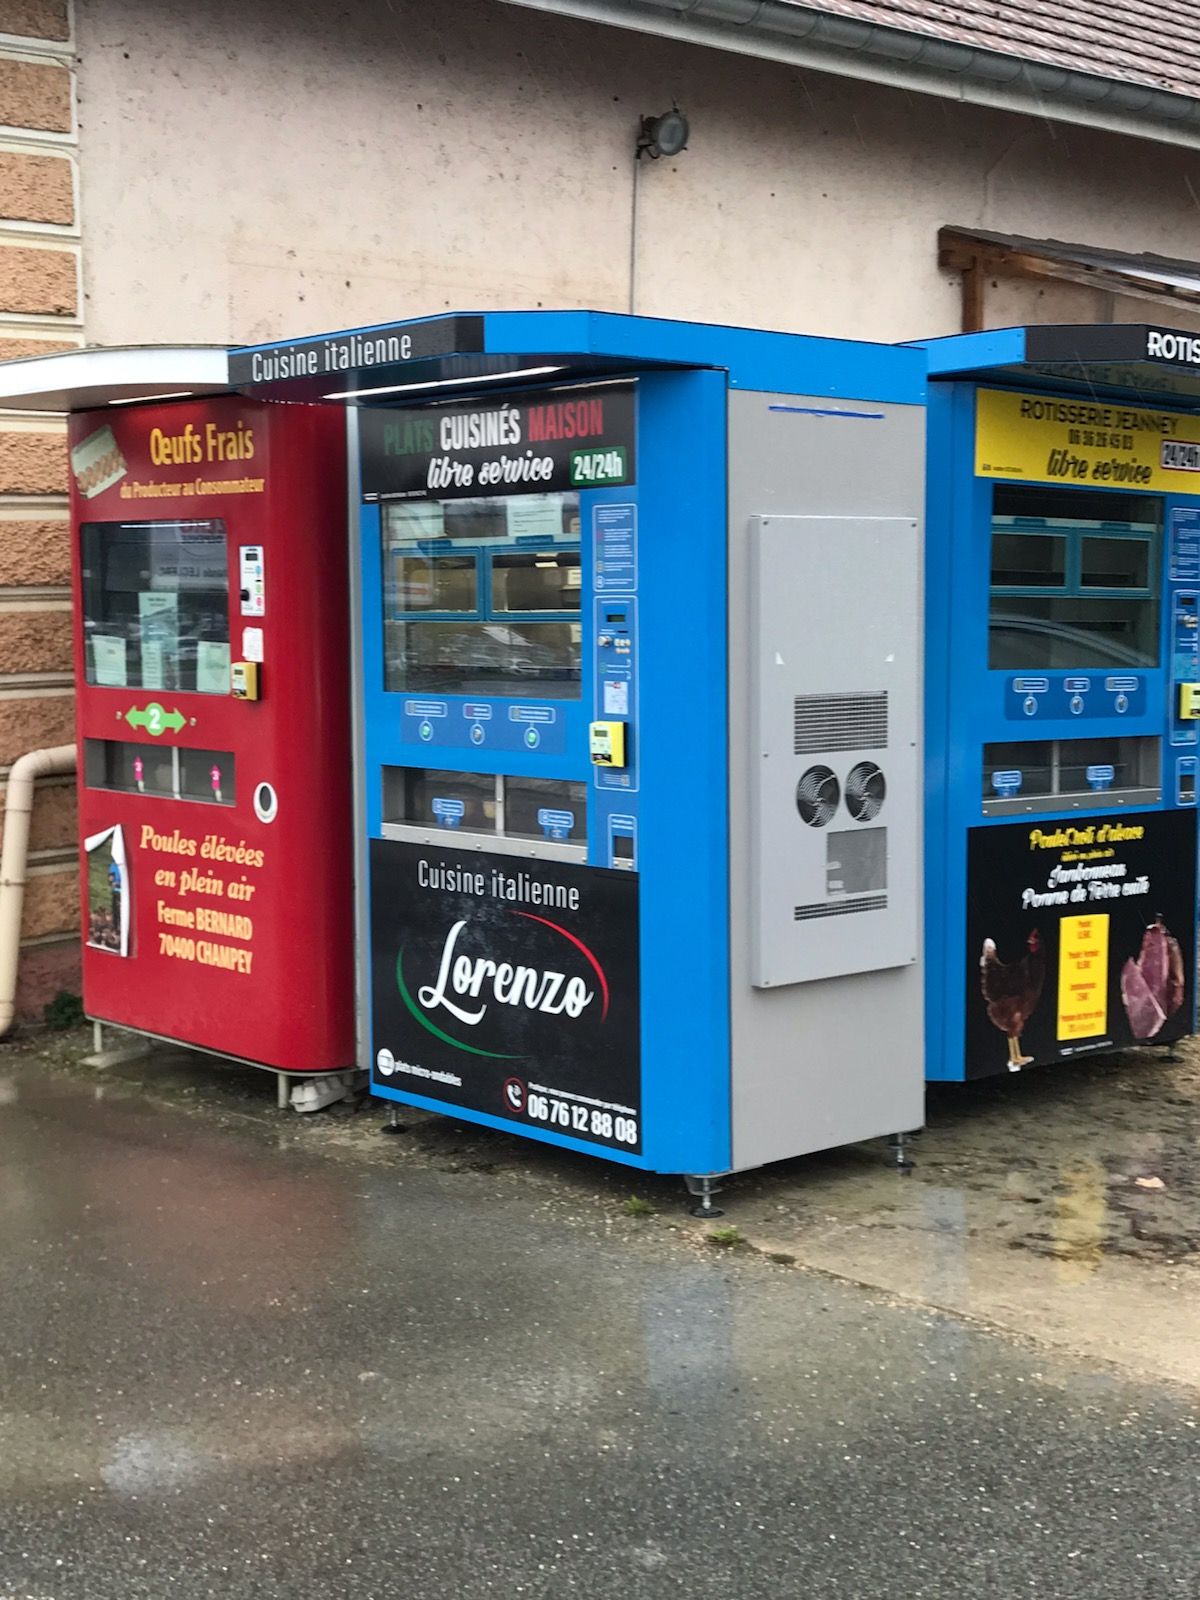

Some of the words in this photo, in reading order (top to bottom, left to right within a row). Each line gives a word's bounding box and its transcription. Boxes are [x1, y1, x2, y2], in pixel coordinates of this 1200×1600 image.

[252, 347, 318, 382] Cuisine
[325, 335, 412, 371] italienne
[440, 403, 520, 451] CUISINÉS
[528, 399, 604, 442] MAISON
[1020, 399, 1112, 428] ROTISSERIE
[151, 424, 202, 465] Œufs
[206, 420, 254, 461] Frais
[427, 456, 474, 488] libre
[478, 450, 554, 485] service
[574, 451, 624, 481] 24/24h
[1047, 449, 1089, 479] libre
[1092, 458, 1153, 485] service
[149, 708, 161, 730] 2
[140, 825, 197, 856] Poules
[155, 869, 176, 888] en
[178, 867, 224, 896] plein
[227, 875, 256, 901] air
[417, 859, 485, 896] Cuisine
[491, 869, 580, 910] italienne
[157, 900, 195, 929] Ferme
[196, 907, 253, 940] BERNARD
[196, 940, 253, 974] CHAMPEY
[418, 920, 595, 1026] Lorenzo
[528, 1094, 549, 1121] 06
[549, 1100, 570, 1127] 76
[571, 1105, 589, 1132] 12
[590, 1110, 613, 1138] 88
[614, 1116, 638, 1145] 08
